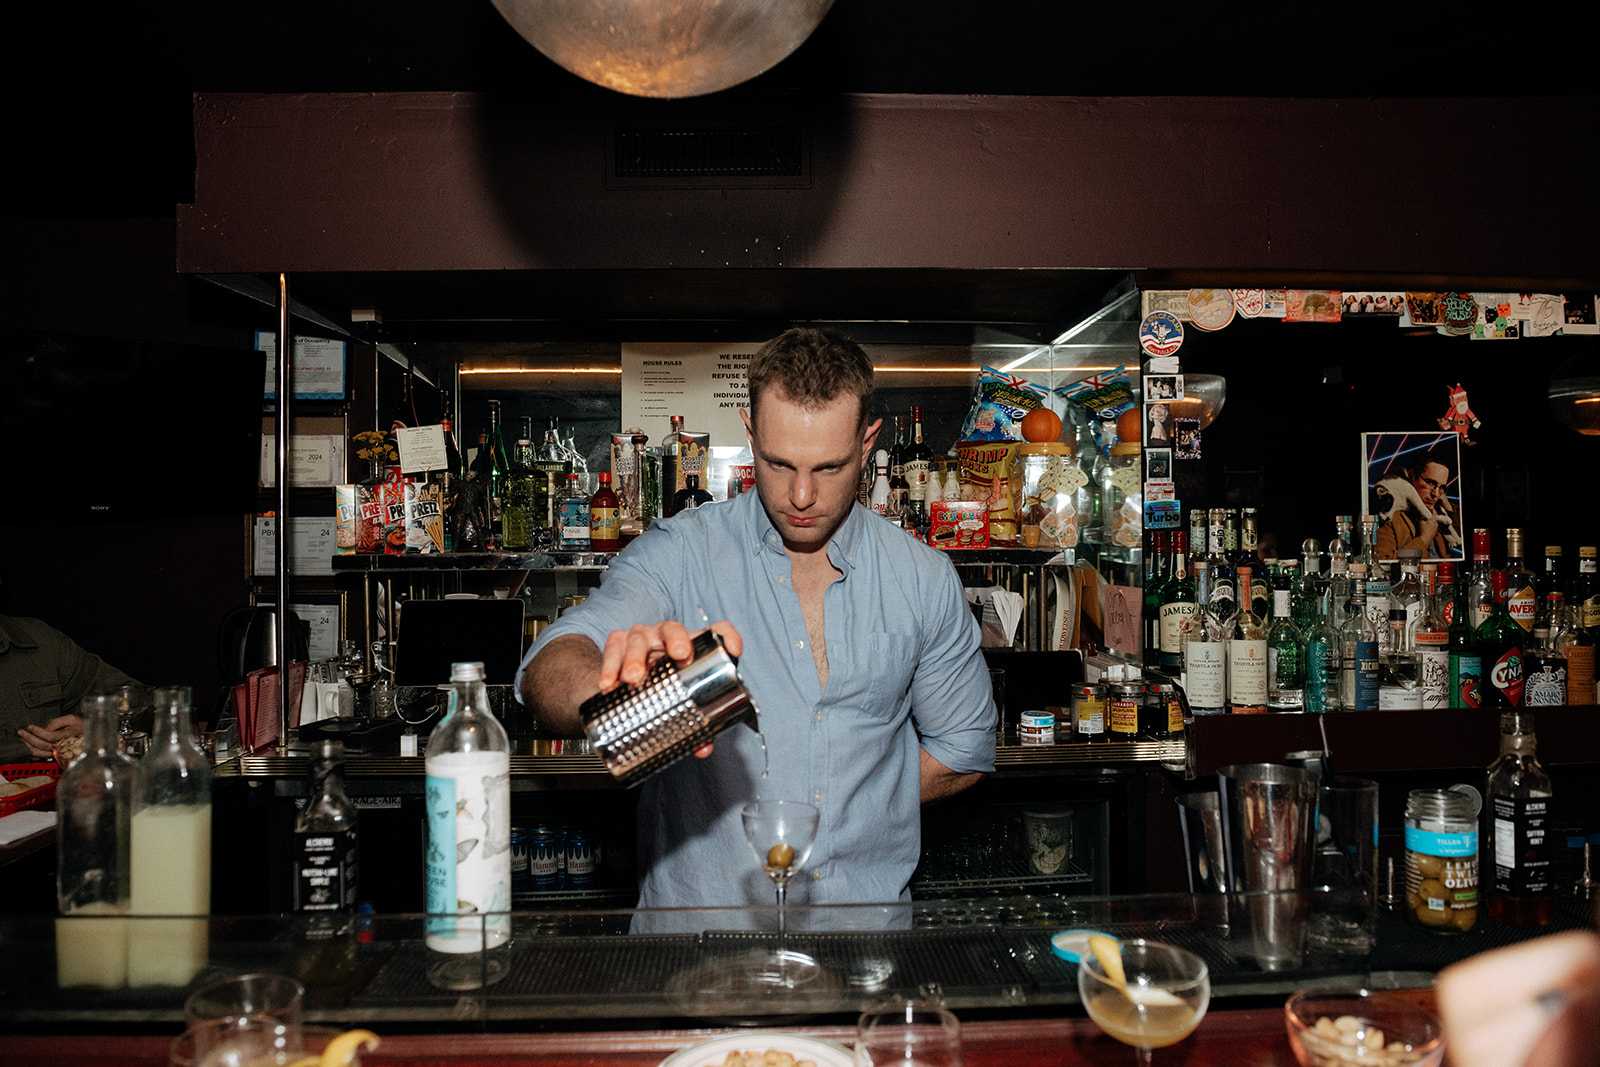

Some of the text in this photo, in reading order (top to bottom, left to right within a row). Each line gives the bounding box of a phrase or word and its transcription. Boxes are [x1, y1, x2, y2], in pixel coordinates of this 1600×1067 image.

[90, 504, 111, 512] SONY
[410, 501, 439, 519] PRETZ
[1145, 511, 1180, 523] Turbo
[320, 528, 330, 537] 24
[319, 617, 330, 625] 24
[1534, 690, 1561, 698] AMARO
